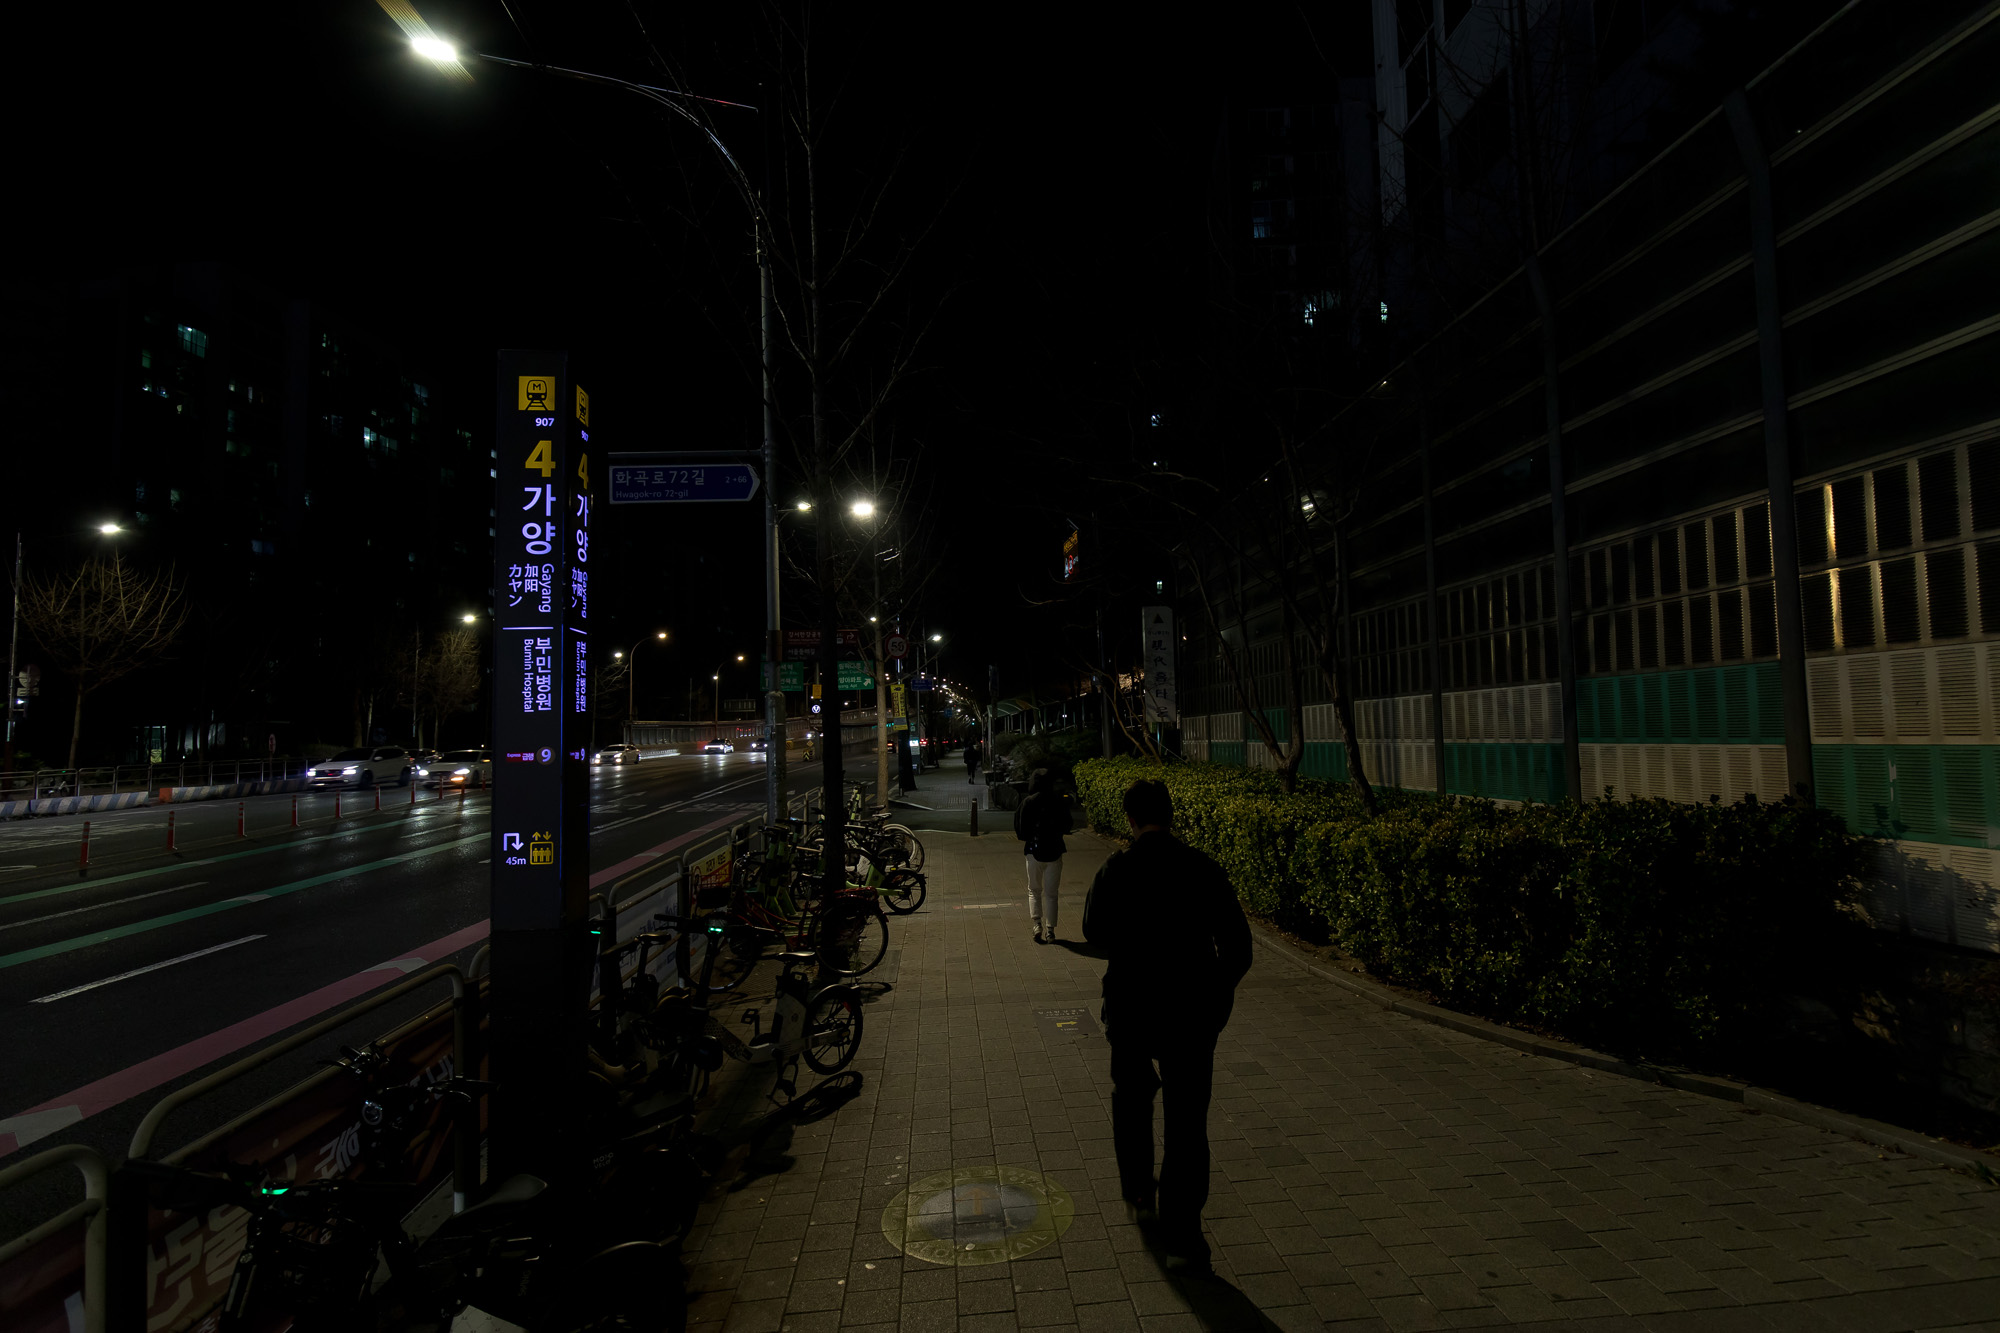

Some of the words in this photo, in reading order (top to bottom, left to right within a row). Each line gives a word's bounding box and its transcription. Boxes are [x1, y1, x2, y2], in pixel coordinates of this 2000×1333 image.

[535, 418, 554, 427] 907
[525, 440, 556, 478] 4
[577, 453, 588, 490] 4
[615, 468, 705, 486] 화곡로72길
[615, 490, 662, 500] Hwagok-ro
[664, 489, 689, 499] 72-gil
[522, 484, 556, 555] 가양
[576, 493, 589, 563] 가양
[508, 563, 523, 607] カヤン
[524, 563, 539, 592] 加阳
[538, 563, 554, 613] Gayang
[523, 638, 534, 671] Bumin
[535, 637, 552, 711] 부민병원
[521, 672, 534, 713] Hospital
[541, 748, 552, 762] 9
[580, 748, 586, 761] 9
[505, 857, 527, 865] 45m
